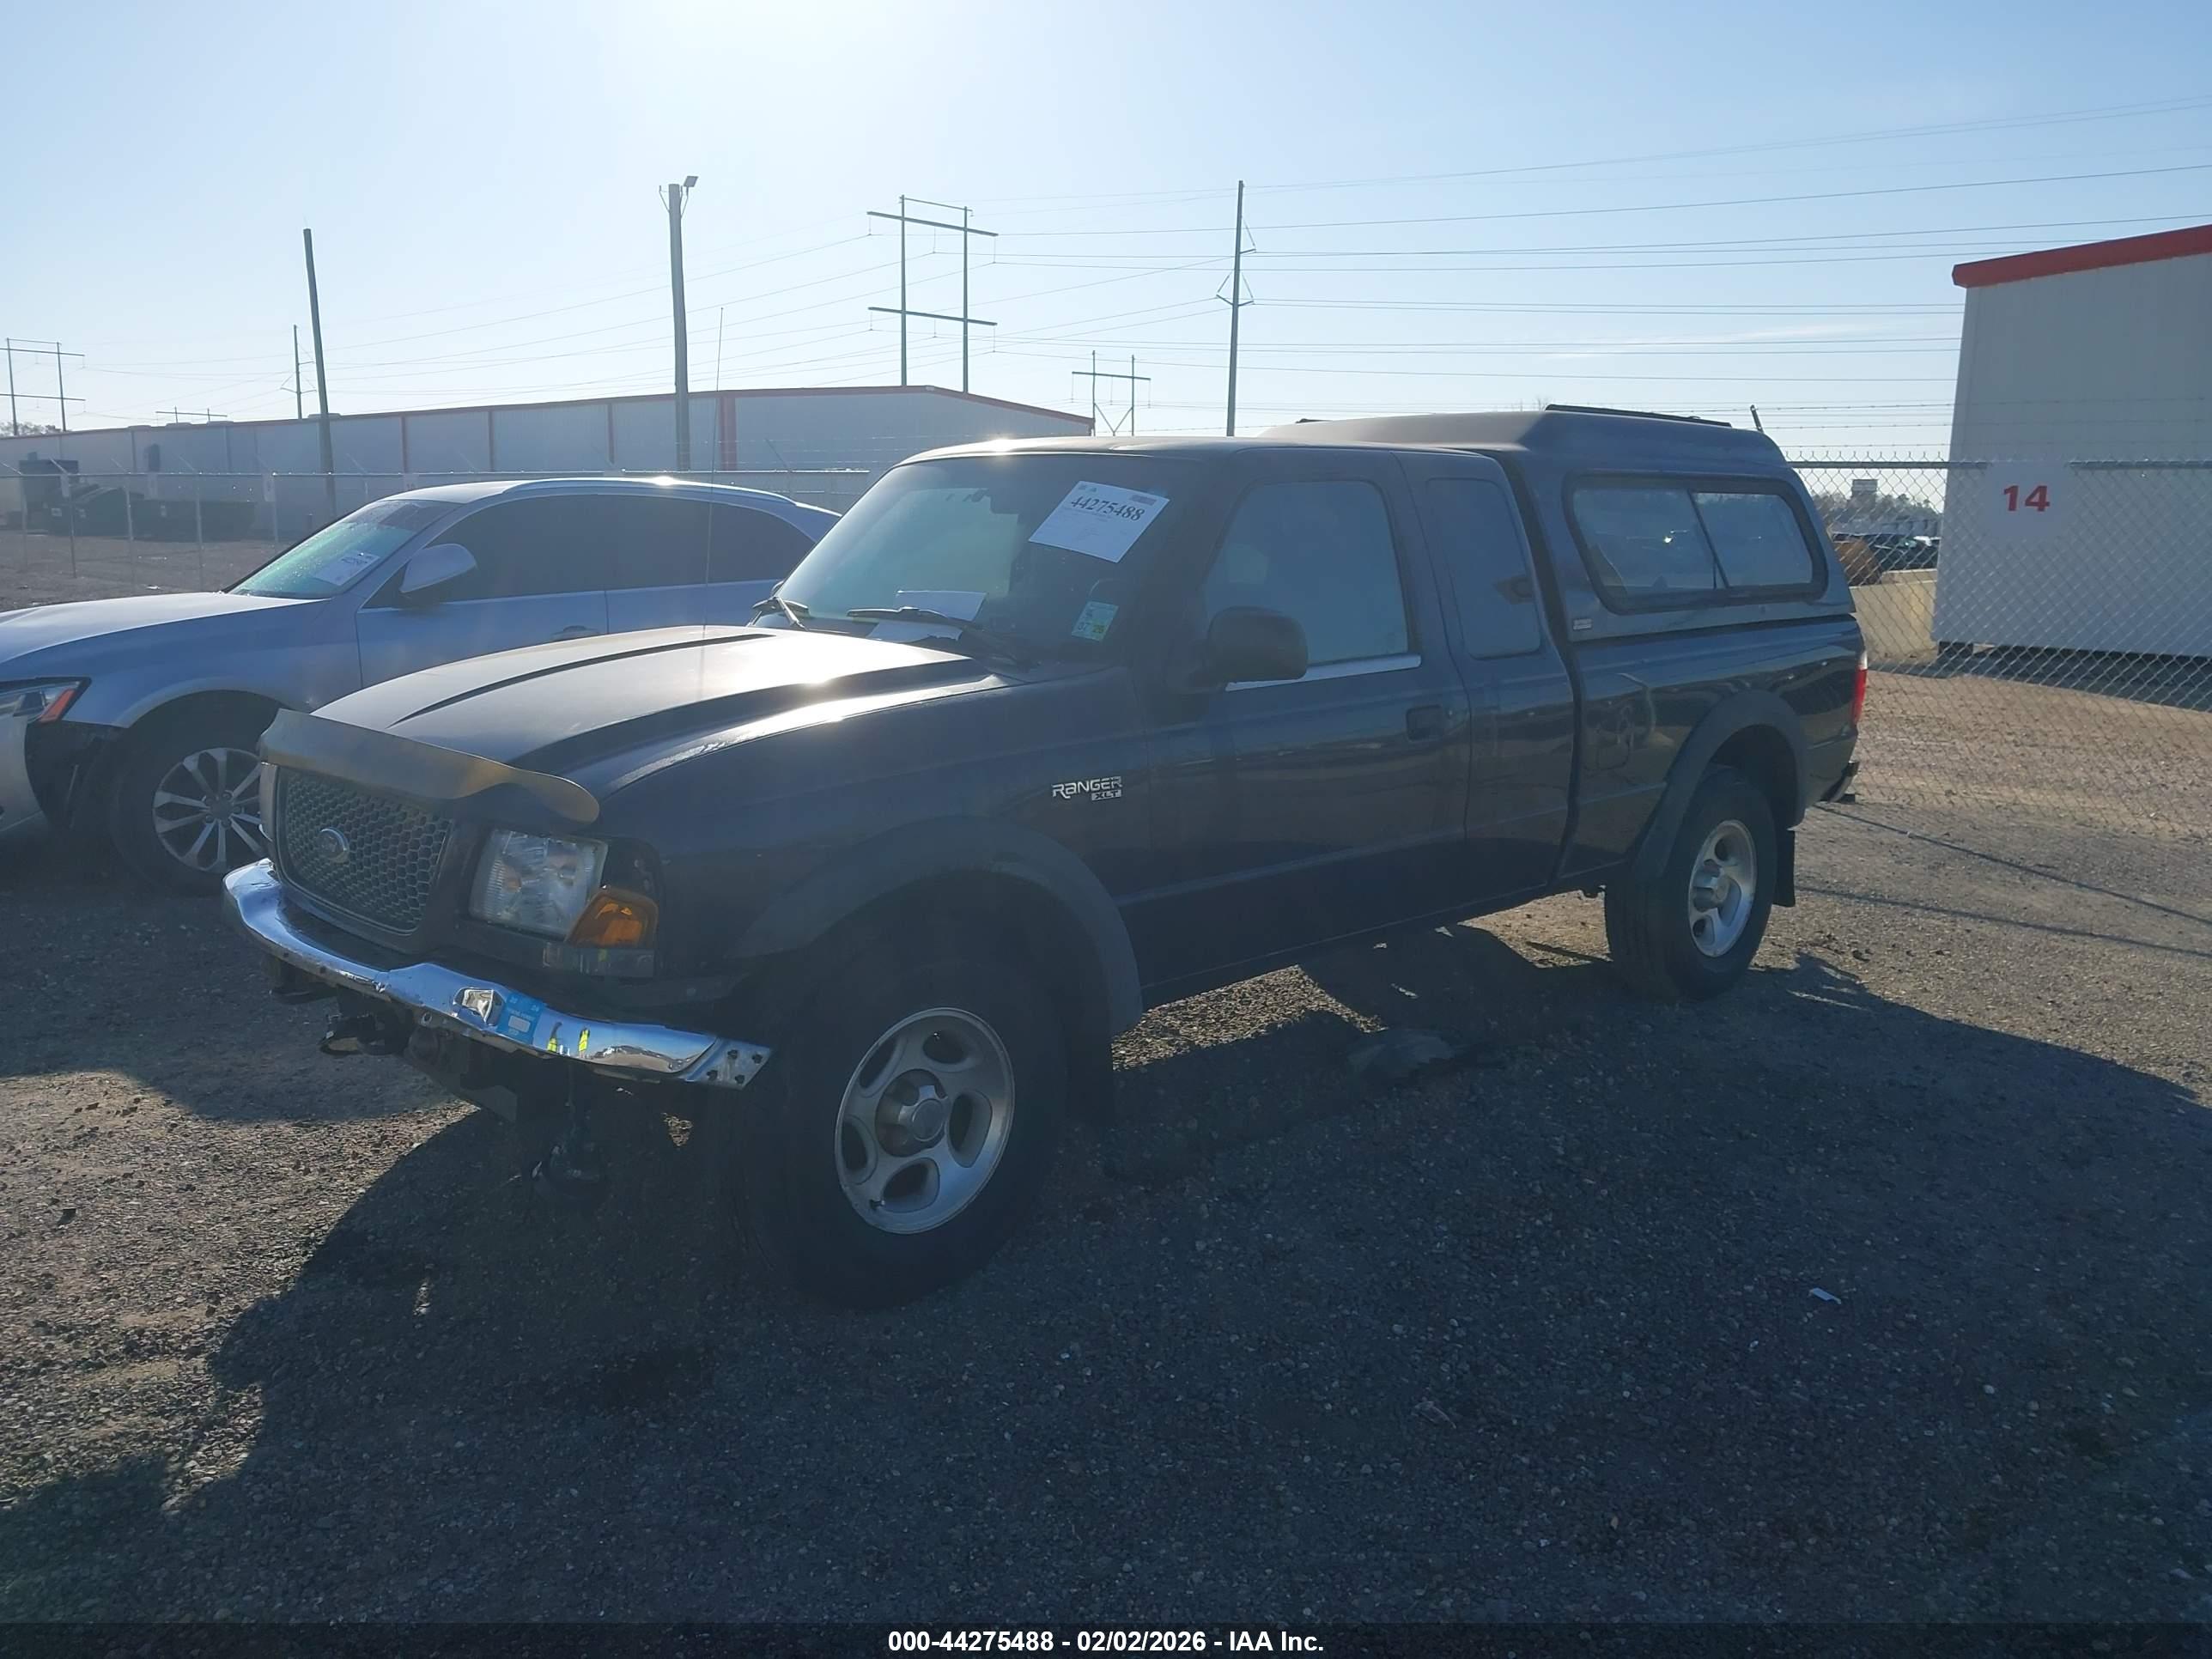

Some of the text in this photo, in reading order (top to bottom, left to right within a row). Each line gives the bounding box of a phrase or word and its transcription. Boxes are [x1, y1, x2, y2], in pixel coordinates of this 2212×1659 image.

[1071, 495, 1146, 521] 44275488
[2003, 484, 2051, 512] 14
[1095, 790, 1120, 800] XLT
